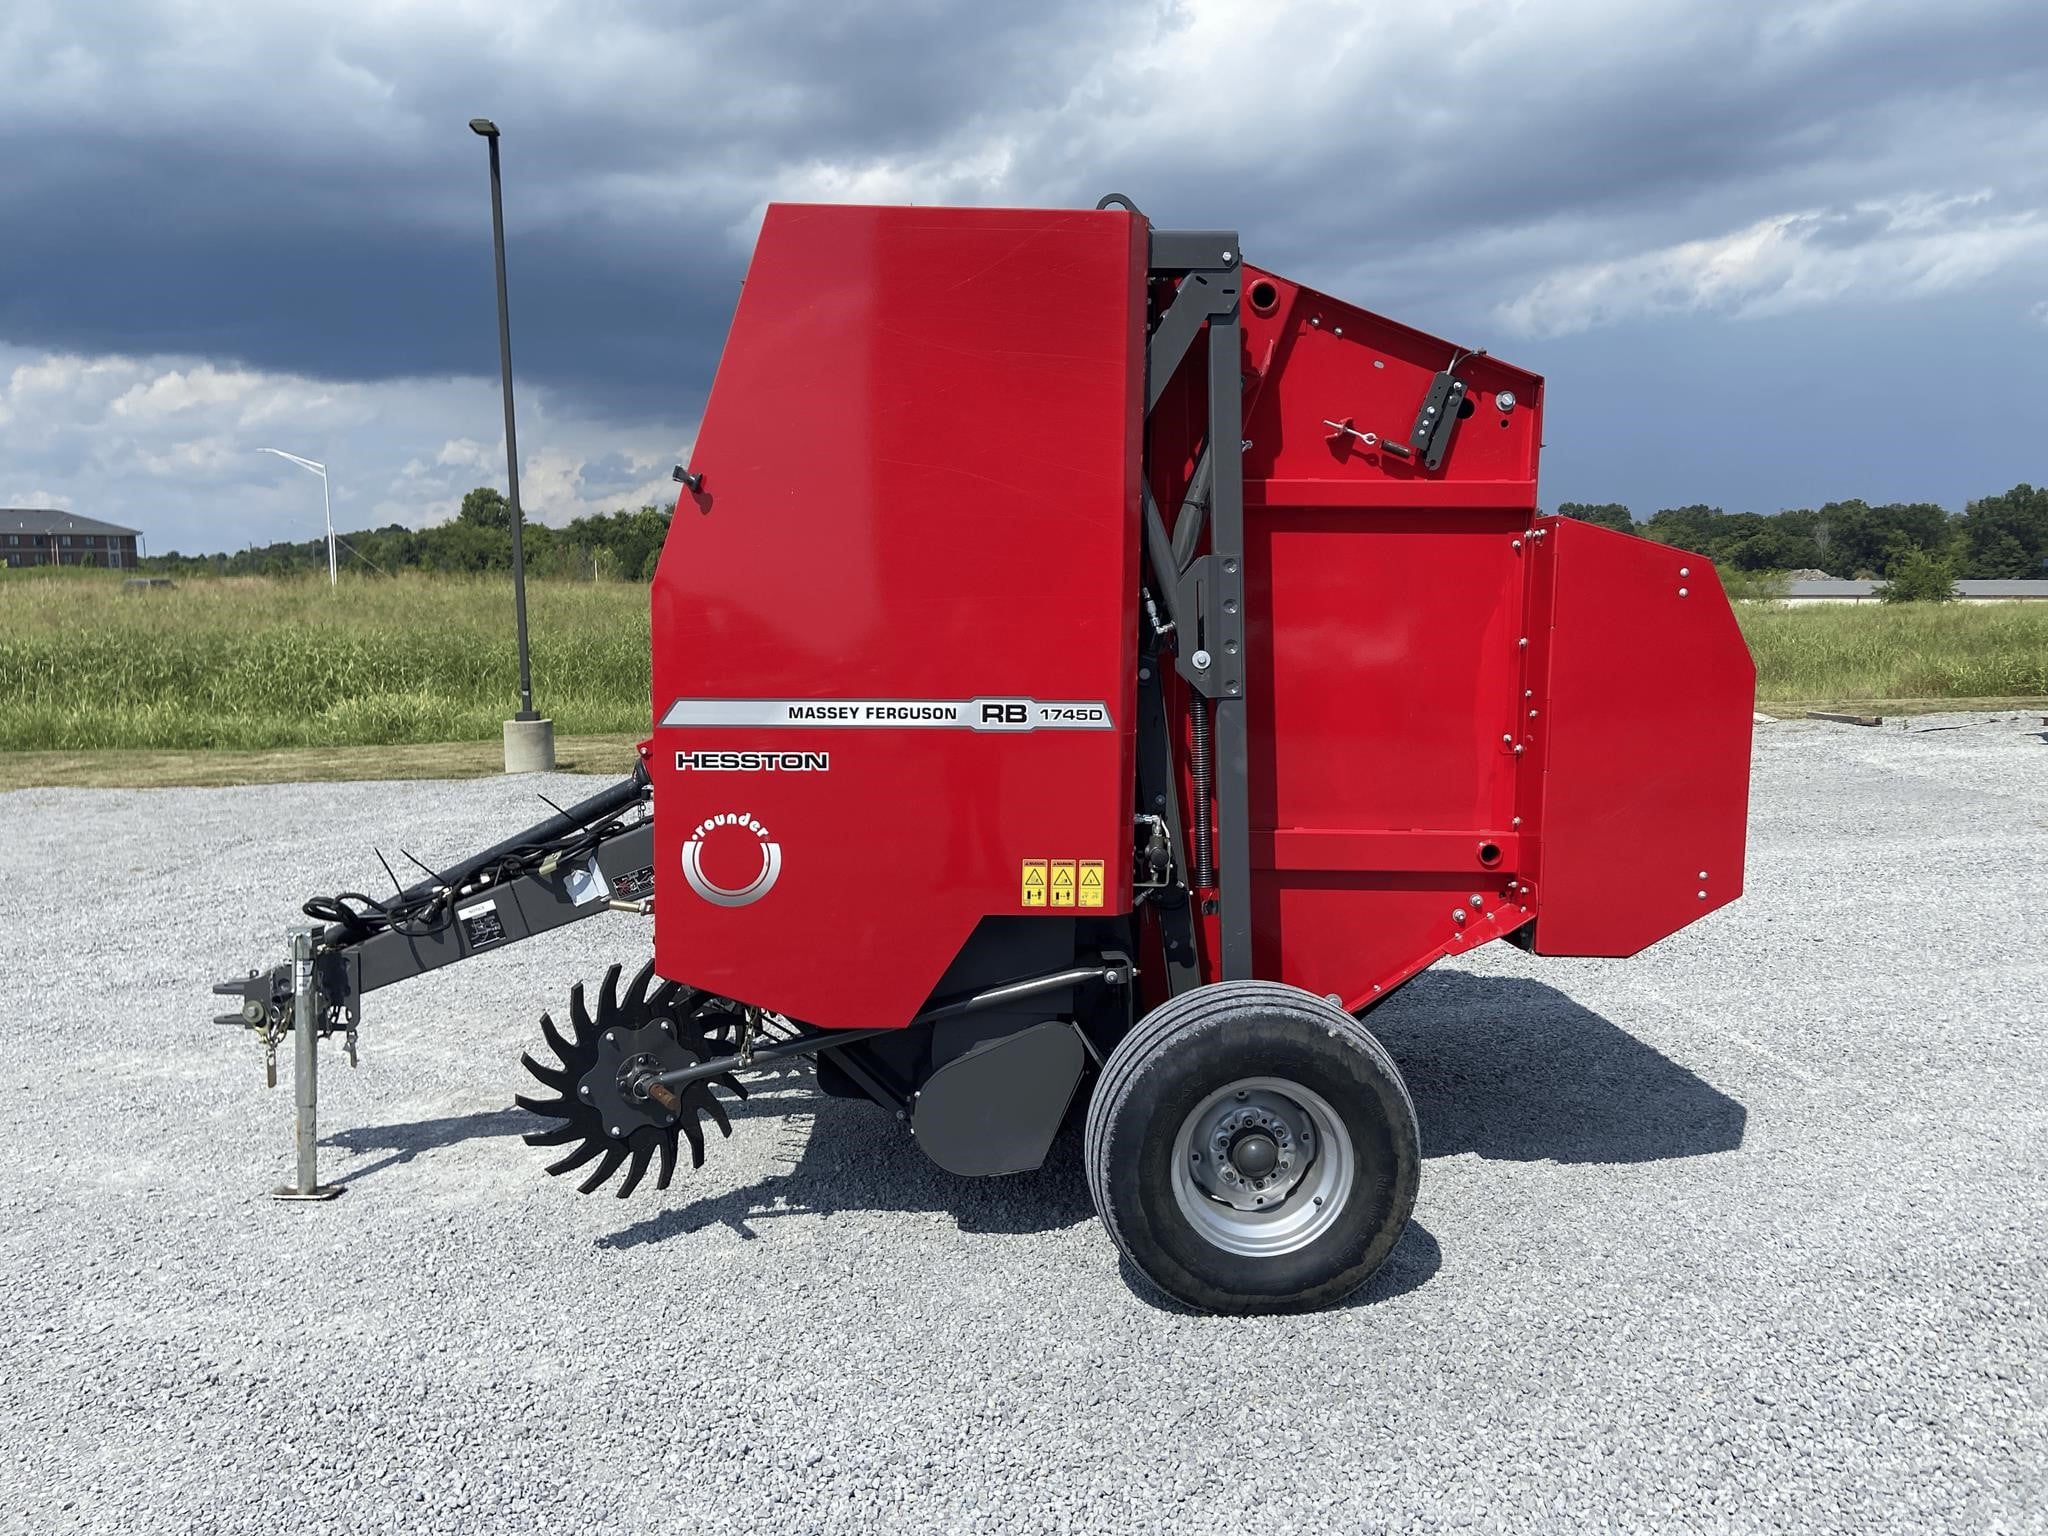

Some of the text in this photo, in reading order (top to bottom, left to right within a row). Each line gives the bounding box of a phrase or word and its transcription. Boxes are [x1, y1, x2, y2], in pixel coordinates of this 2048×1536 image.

[789, 704, 1103, 723] MASSEY FERGUSON RB 1745D
[676, 752, 829, 771] HESSTON
